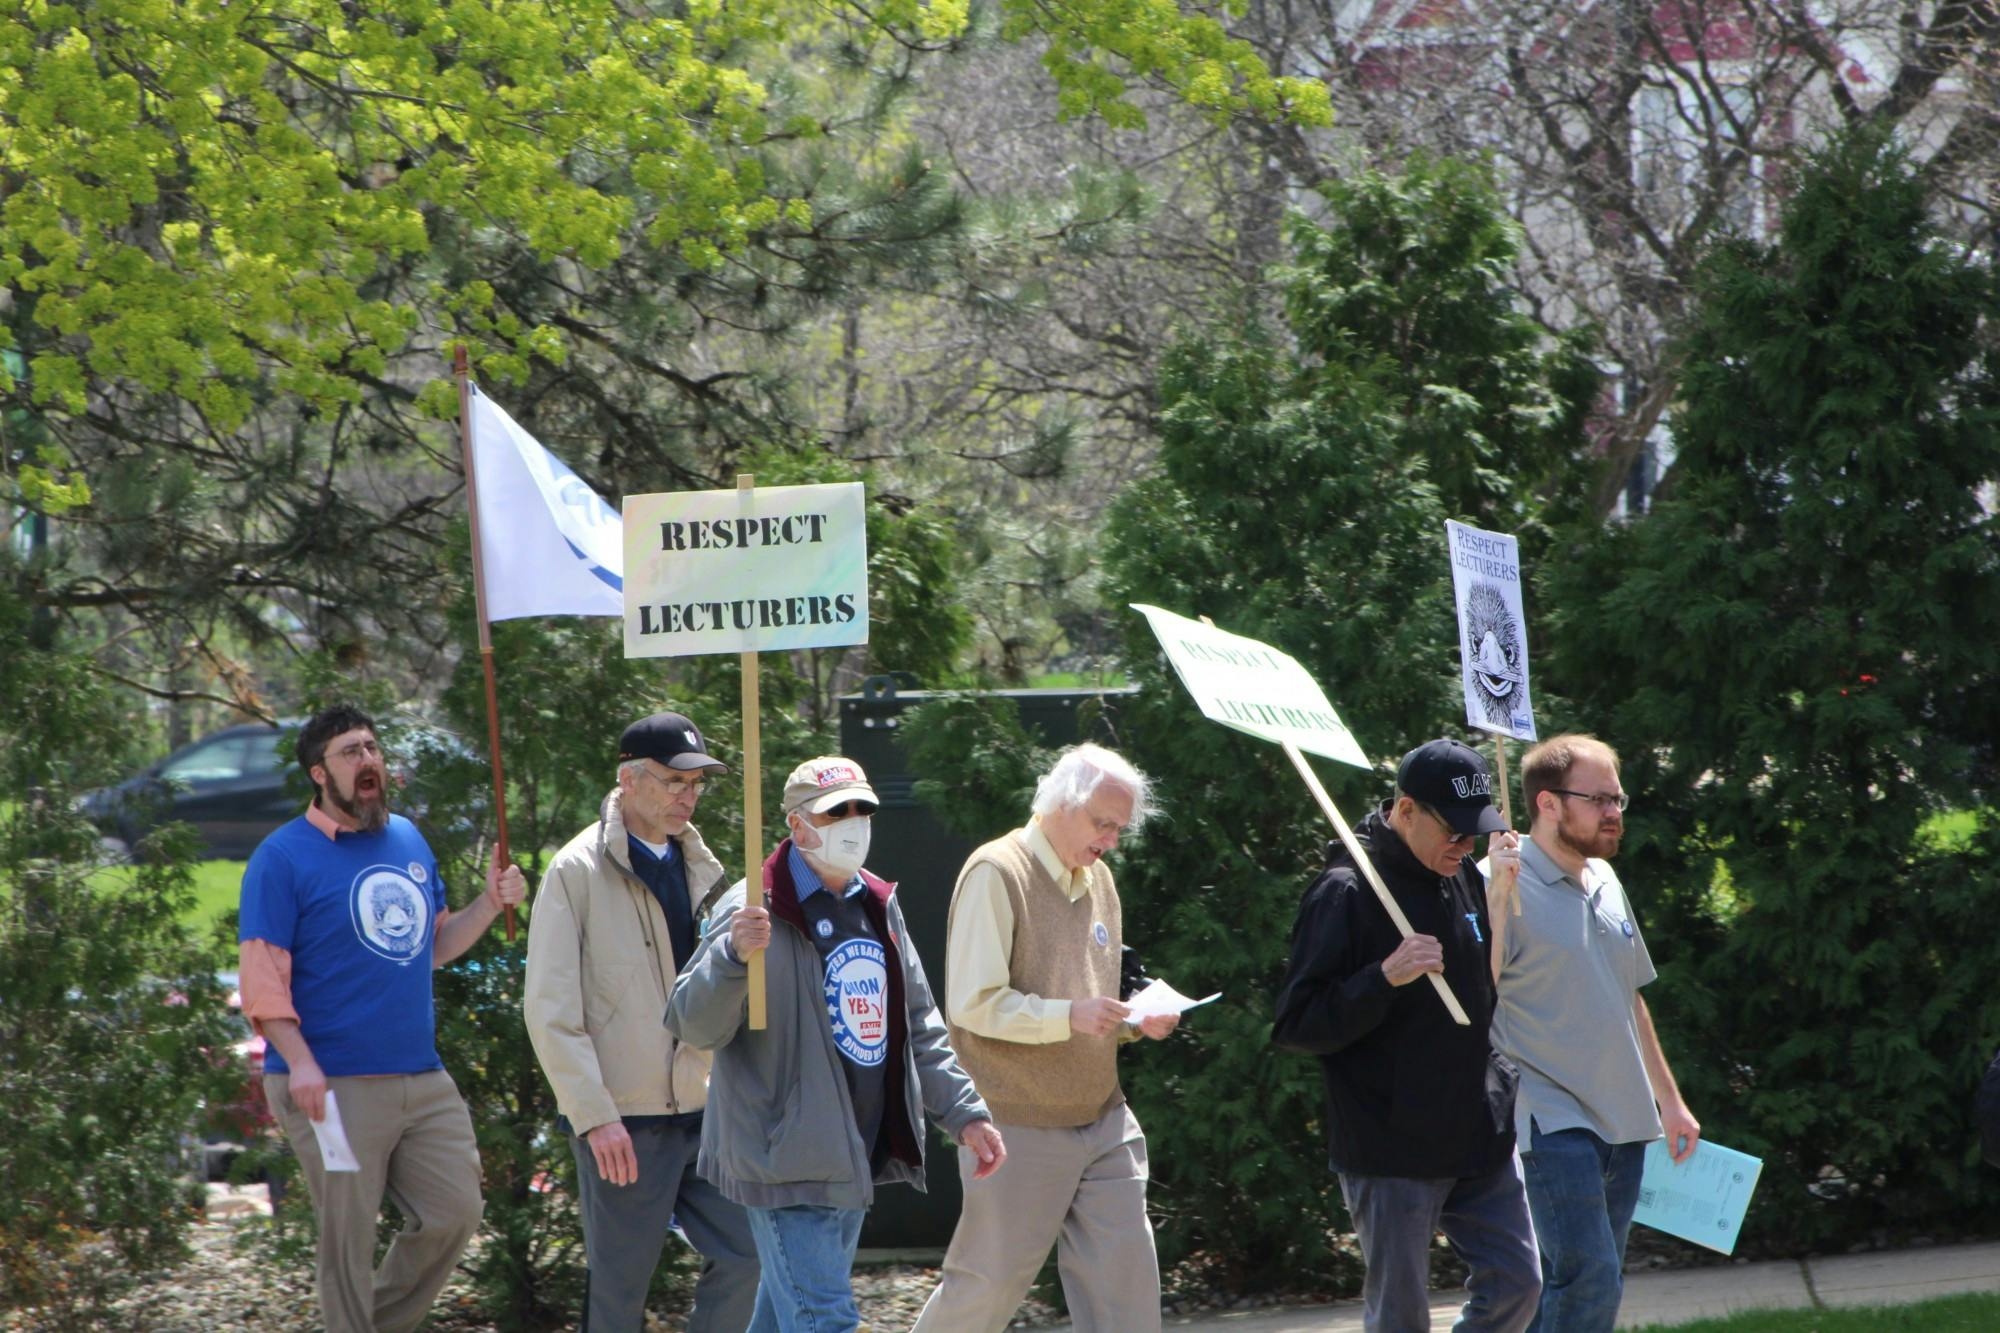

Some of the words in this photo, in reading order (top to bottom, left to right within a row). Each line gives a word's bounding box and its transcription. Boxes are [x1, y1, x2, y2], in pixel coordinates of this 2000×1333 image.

[661, 514, 827, 550] RESPECT
[1457, 528, 1507, 559] RESPECT
[1454, 546, 1517, 582] LECTURERS
[638, 594, 856, 635] LECTURERS
[1216, 698, 1346, 732] LECTURERS
[844, 976, 880, 996] UNION
[848, 997, 870, 1015] YES
